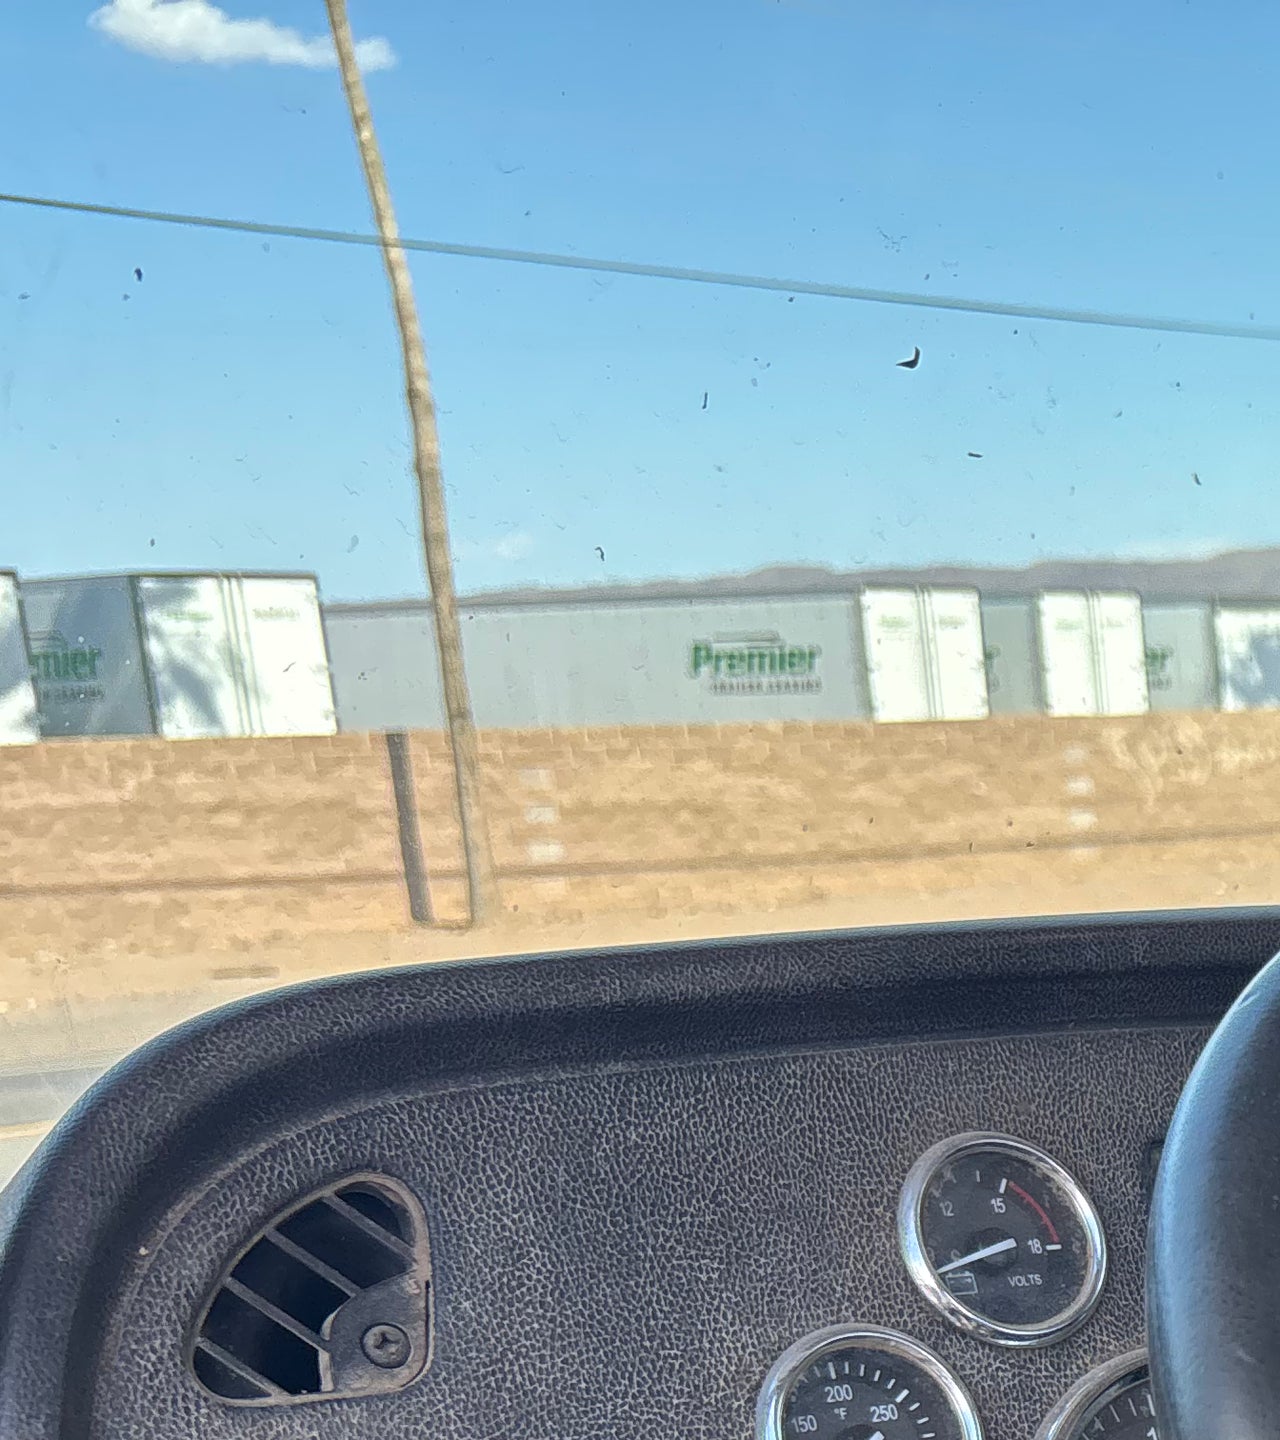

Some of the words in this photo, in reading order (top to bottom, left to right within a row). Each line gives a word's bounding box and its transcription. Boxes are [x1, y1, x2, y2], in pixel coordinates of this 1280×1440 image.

[691, 642, 821, 677] Premier
[939, 1201, 954, 1217] 12
[990, 1198, 1006, 1214] 15
[1027, 1238, 1043, 1254] 18
[1007, 1273, 1043, 1288] VOLTS
[824, 1384, 853, 1403] 200
[870, 1403, 898, 1423] 250
[791, 1414, 818, 1433] 150
